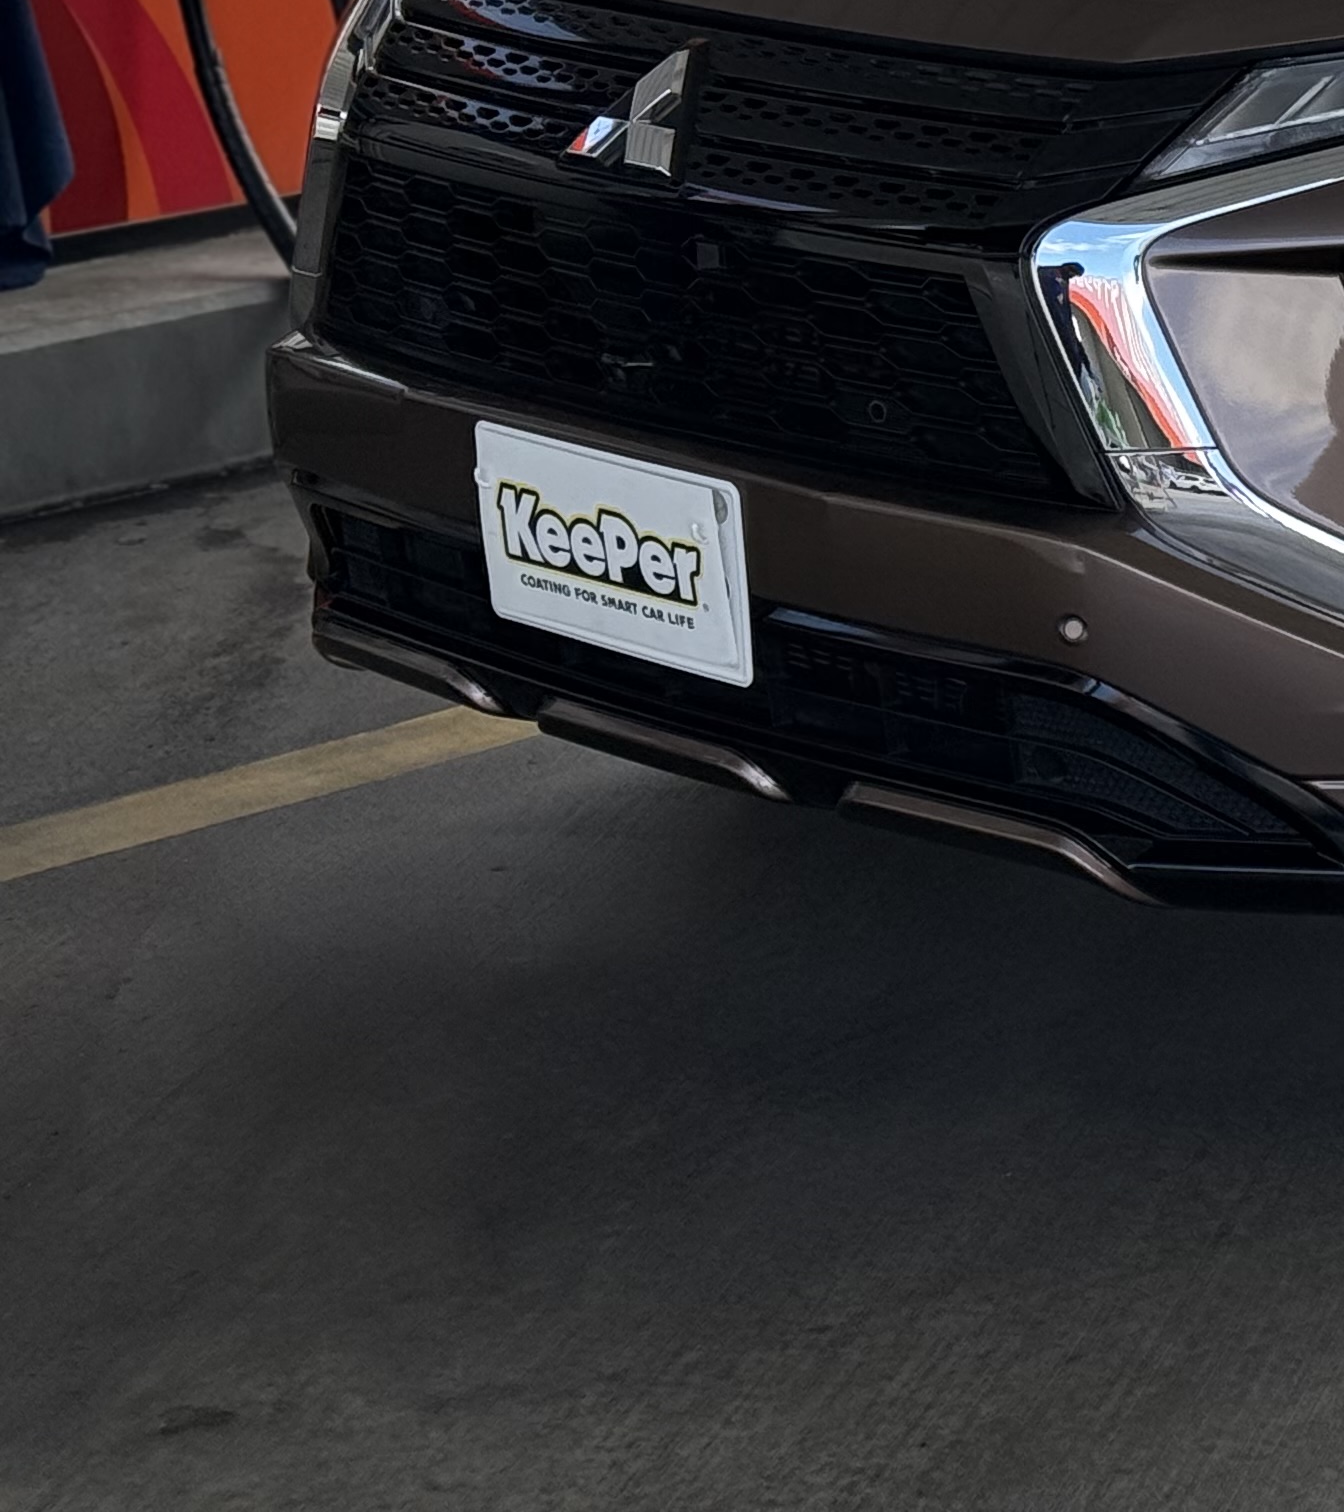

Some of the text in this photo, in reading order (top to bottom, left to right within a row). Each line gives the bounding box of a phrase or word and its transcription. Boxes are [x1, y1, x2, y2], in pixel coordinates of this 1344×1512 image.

[497, 481, 702, 607] KeePer
[520, 573, 696, 630] COATING FOR SMART CAR LIFE
